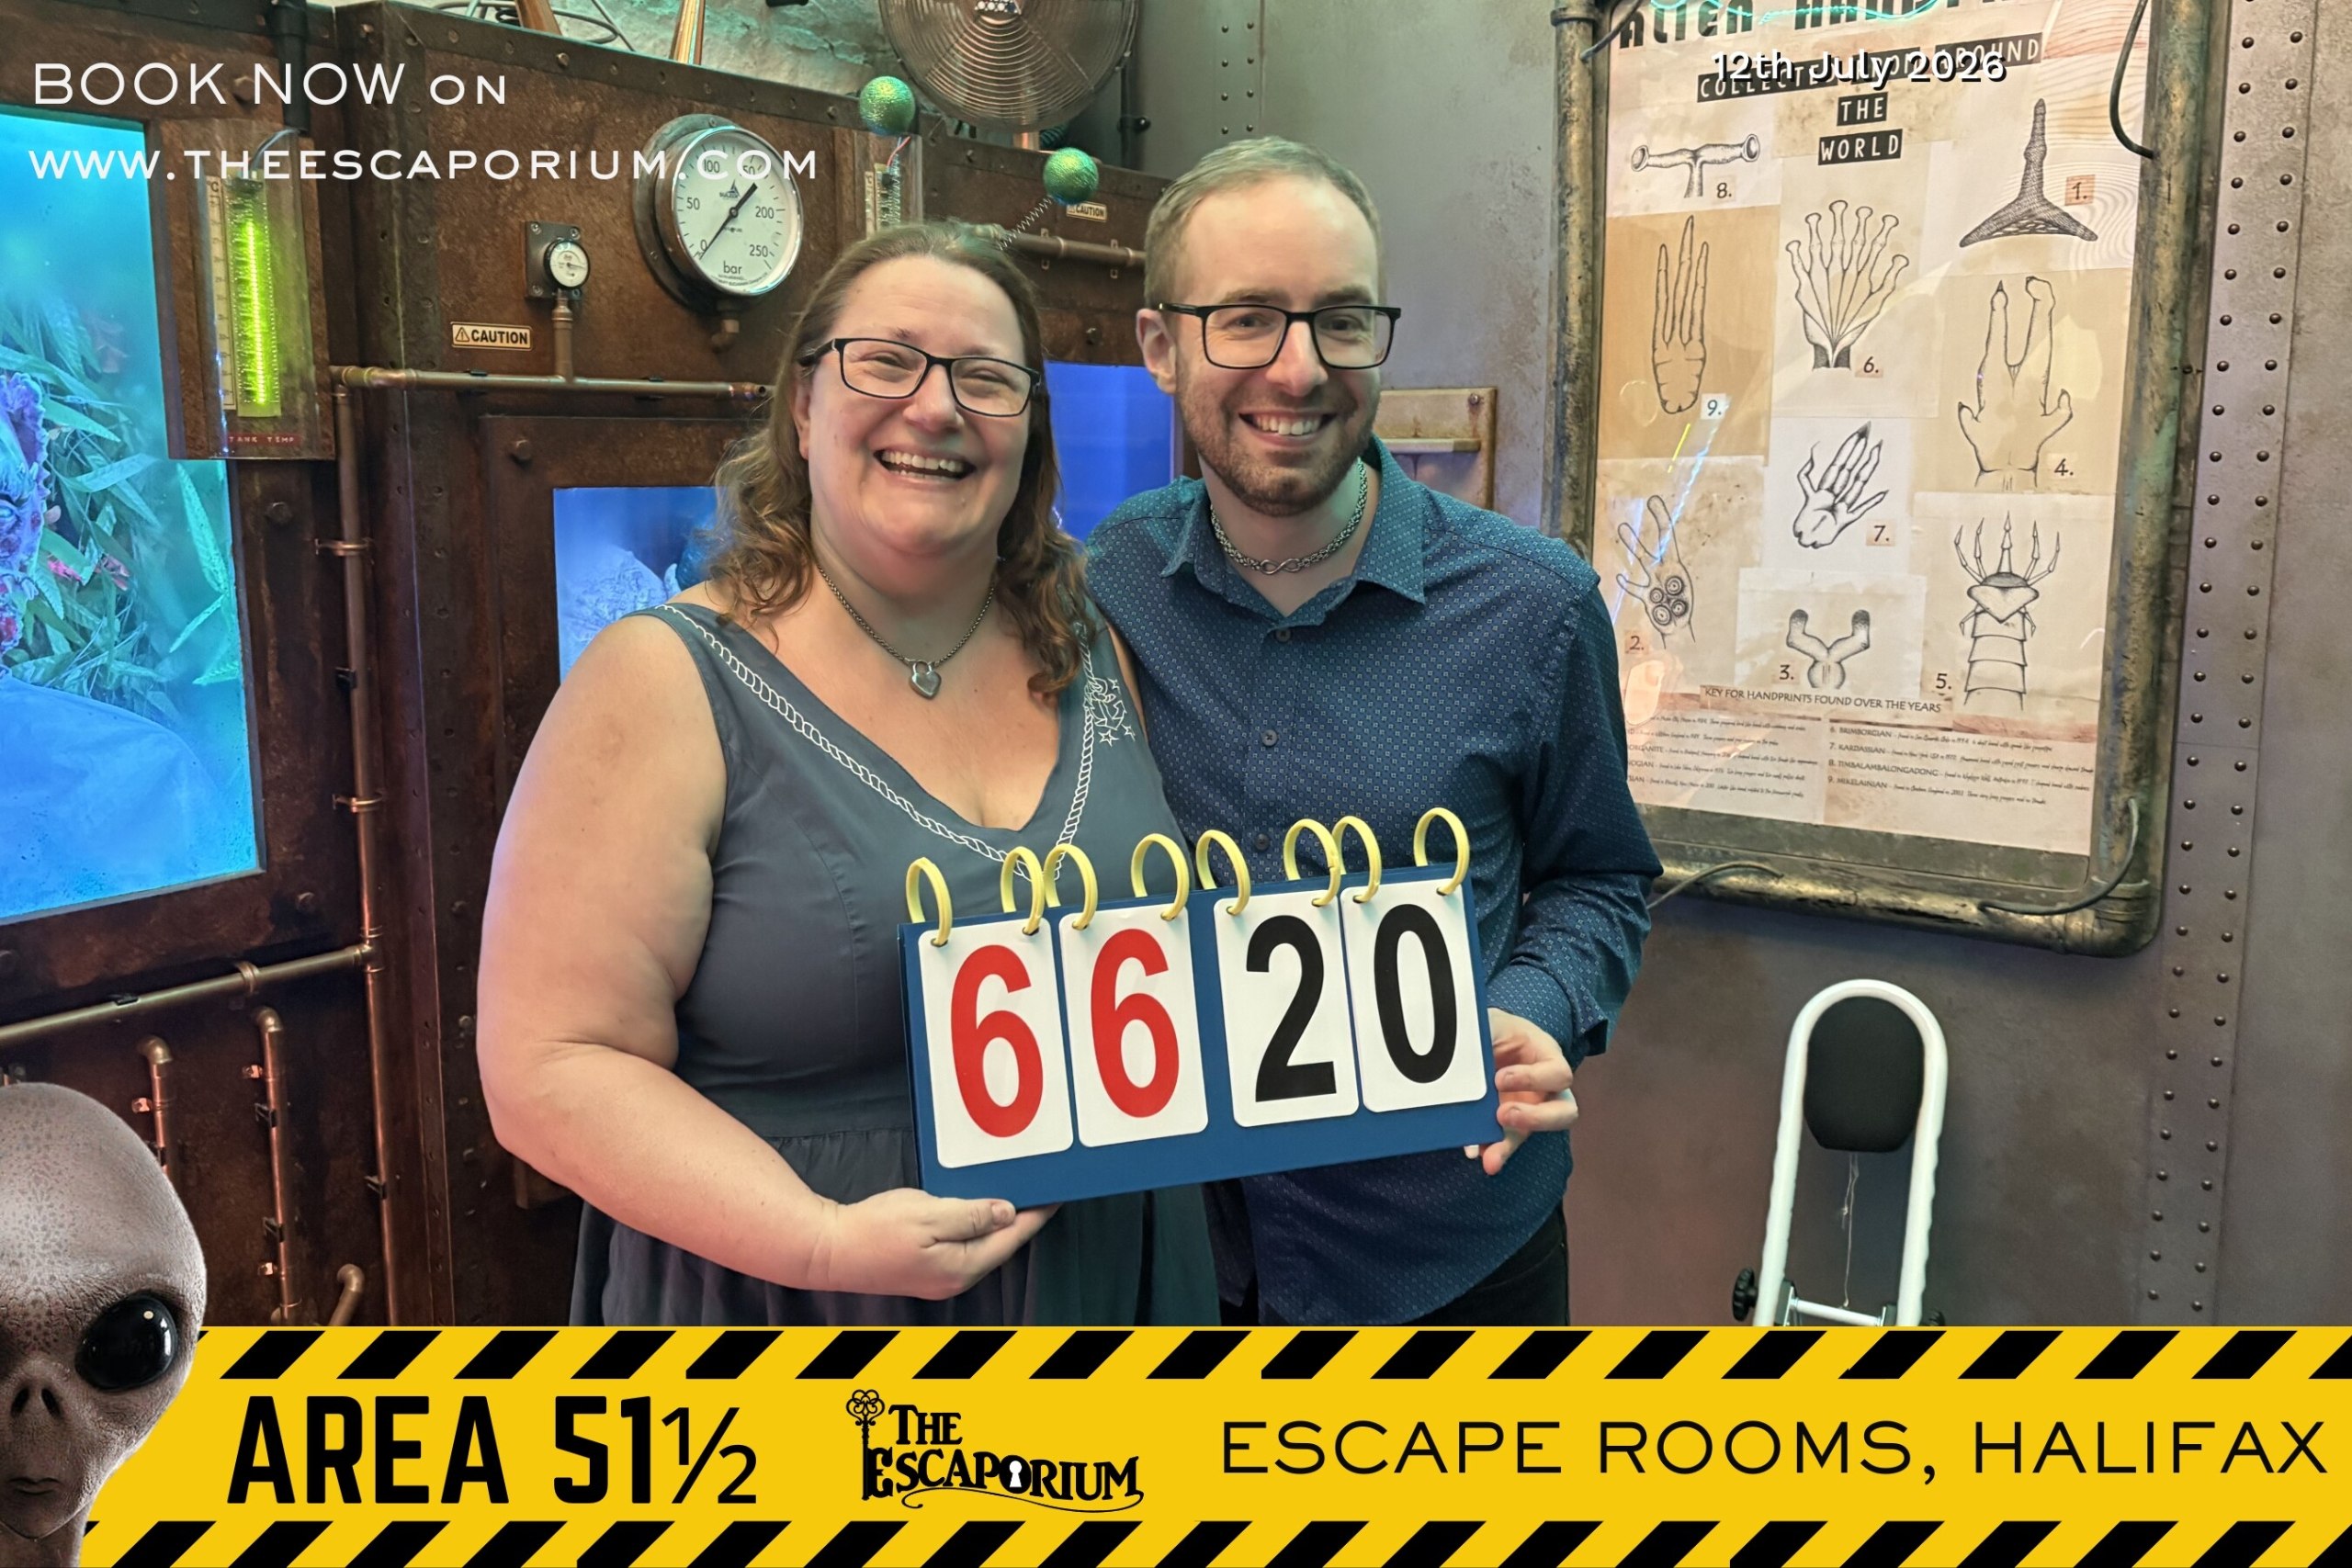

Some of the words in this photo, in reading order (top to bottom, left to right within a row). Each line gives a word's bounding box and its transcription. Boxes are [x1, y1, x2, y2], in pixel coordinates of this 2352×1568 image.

[1840, 97, 1884, 121] THE
[1820, 135, 1899, 160] WORLD
[704, 159, 720, 174] 100
[1716, 182, 1732, 198] 8.
[2072, 181, 2088, 201] 1.
[686, 197, 701, 210] 50
[1076, 204, 1104, 218] CAUTION
[755, 206, 775, 219] 200
[700, 239, 707, 251] 0
[749, 244, 769, 258] 250
[723, 260, 742, 275] bar
[471, 330, 528, 344] CAUTION
[1863, 356, 1880, 374] 6.
[1707, 400, 1722, 416] 9.
[2054, 458, 2075, 477] 4.
[1873, 525, 1890, 543] 7.
[1631, 636, 1645, 651] 2.
[1779, 664, 1794, 681] 3.
[1936, 673, 1952, 690] 5.
[1705, 689, 1723, 697] KEY
[1725, 690, 1745, 699] FOR
[1747, 691, 1812, 704] HANDPRINTS
[1815, 695, 1851, 706] FOUND
[1854, 697, 1883, 708] OVER
[1885, 699, 1905, 710] THE
[1907, 702, 1941, 713] YEARS
